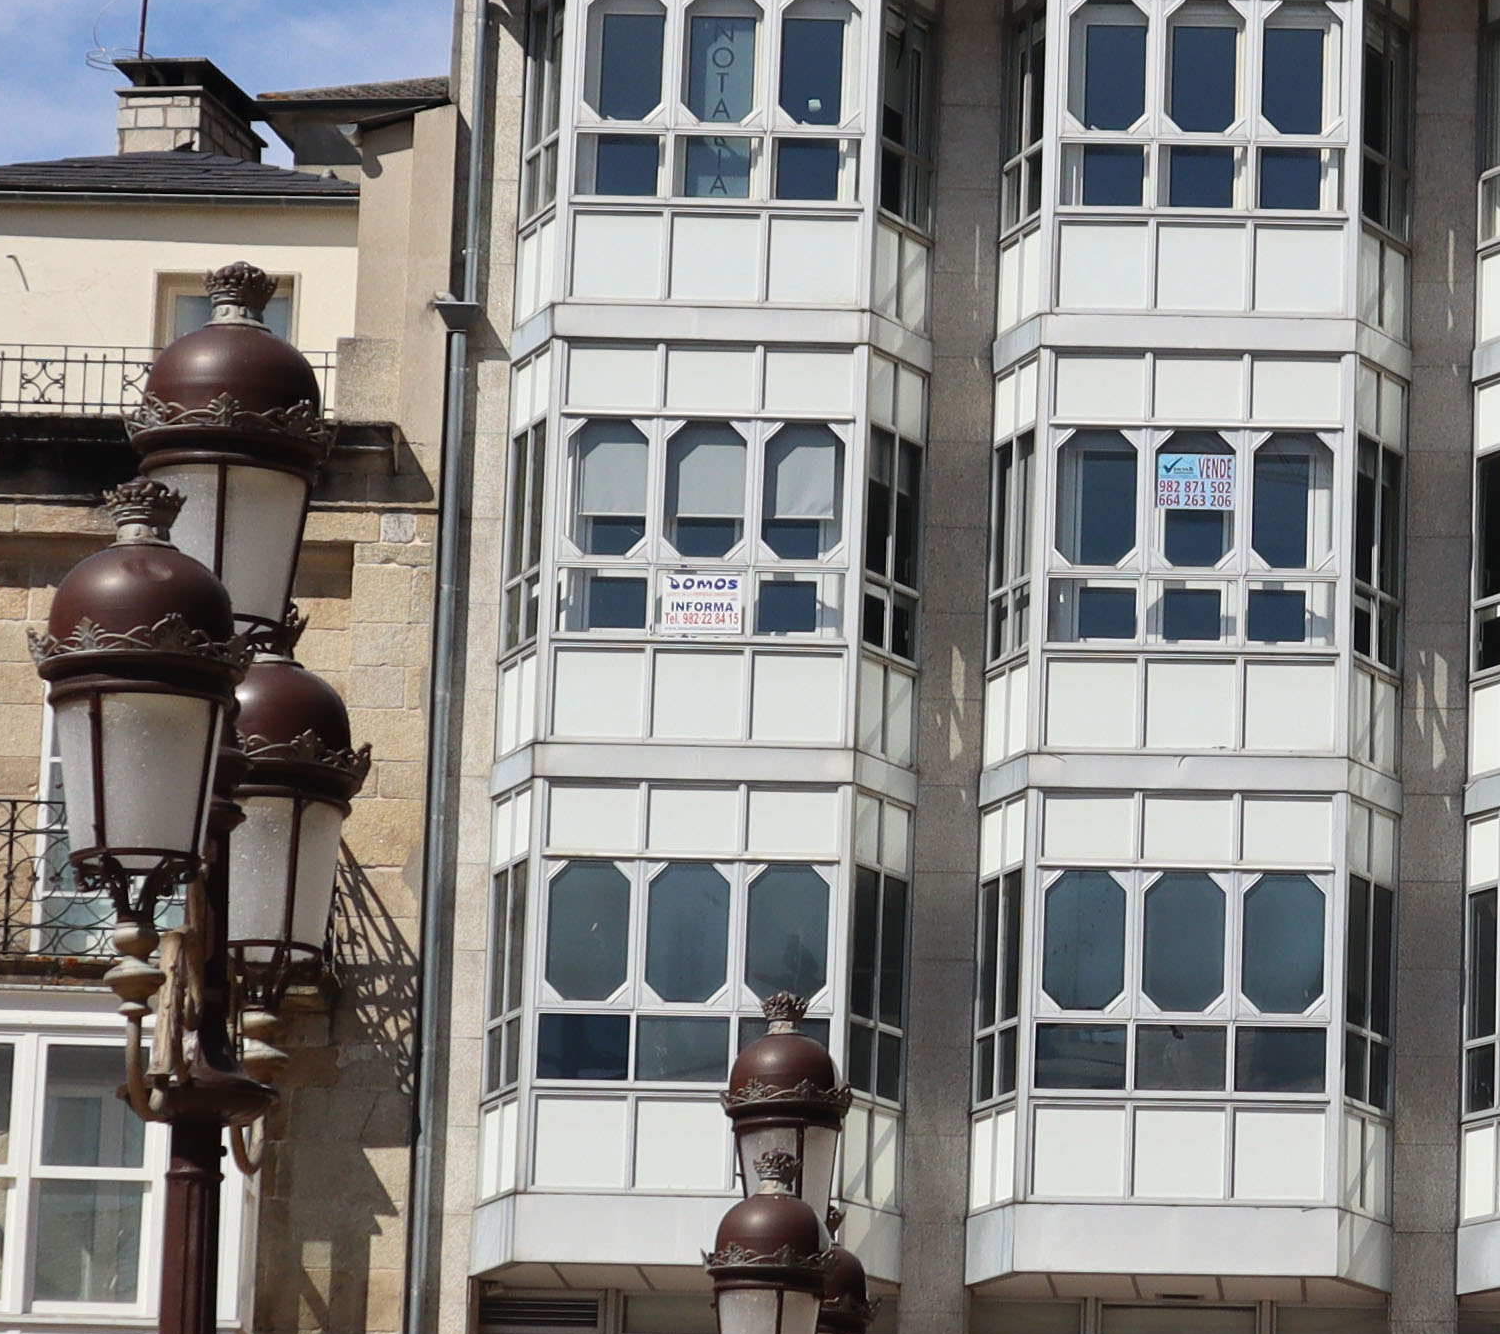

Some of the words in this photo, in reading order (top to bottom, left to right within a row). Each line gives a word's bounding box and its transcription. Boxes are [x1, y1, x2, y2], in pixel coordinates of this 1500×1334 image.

[1198, 458, 1232, 479] VENDE
[1159, 479, 1181, 493] 982
[1184, 480, 1206, 493] 871
[1210, 481, 1232, 494] 502
[1158, 494, 1180, 506] 664
[1184, 495, 1206, 507] 263
[1210, 495, 1232, 508] 206
[671, 601, 734, 612] INFORMA
[664, 612, 680, 625] Tel.
[714, 612, 726, 625] 84
[729, 612, 739, 625] 15
